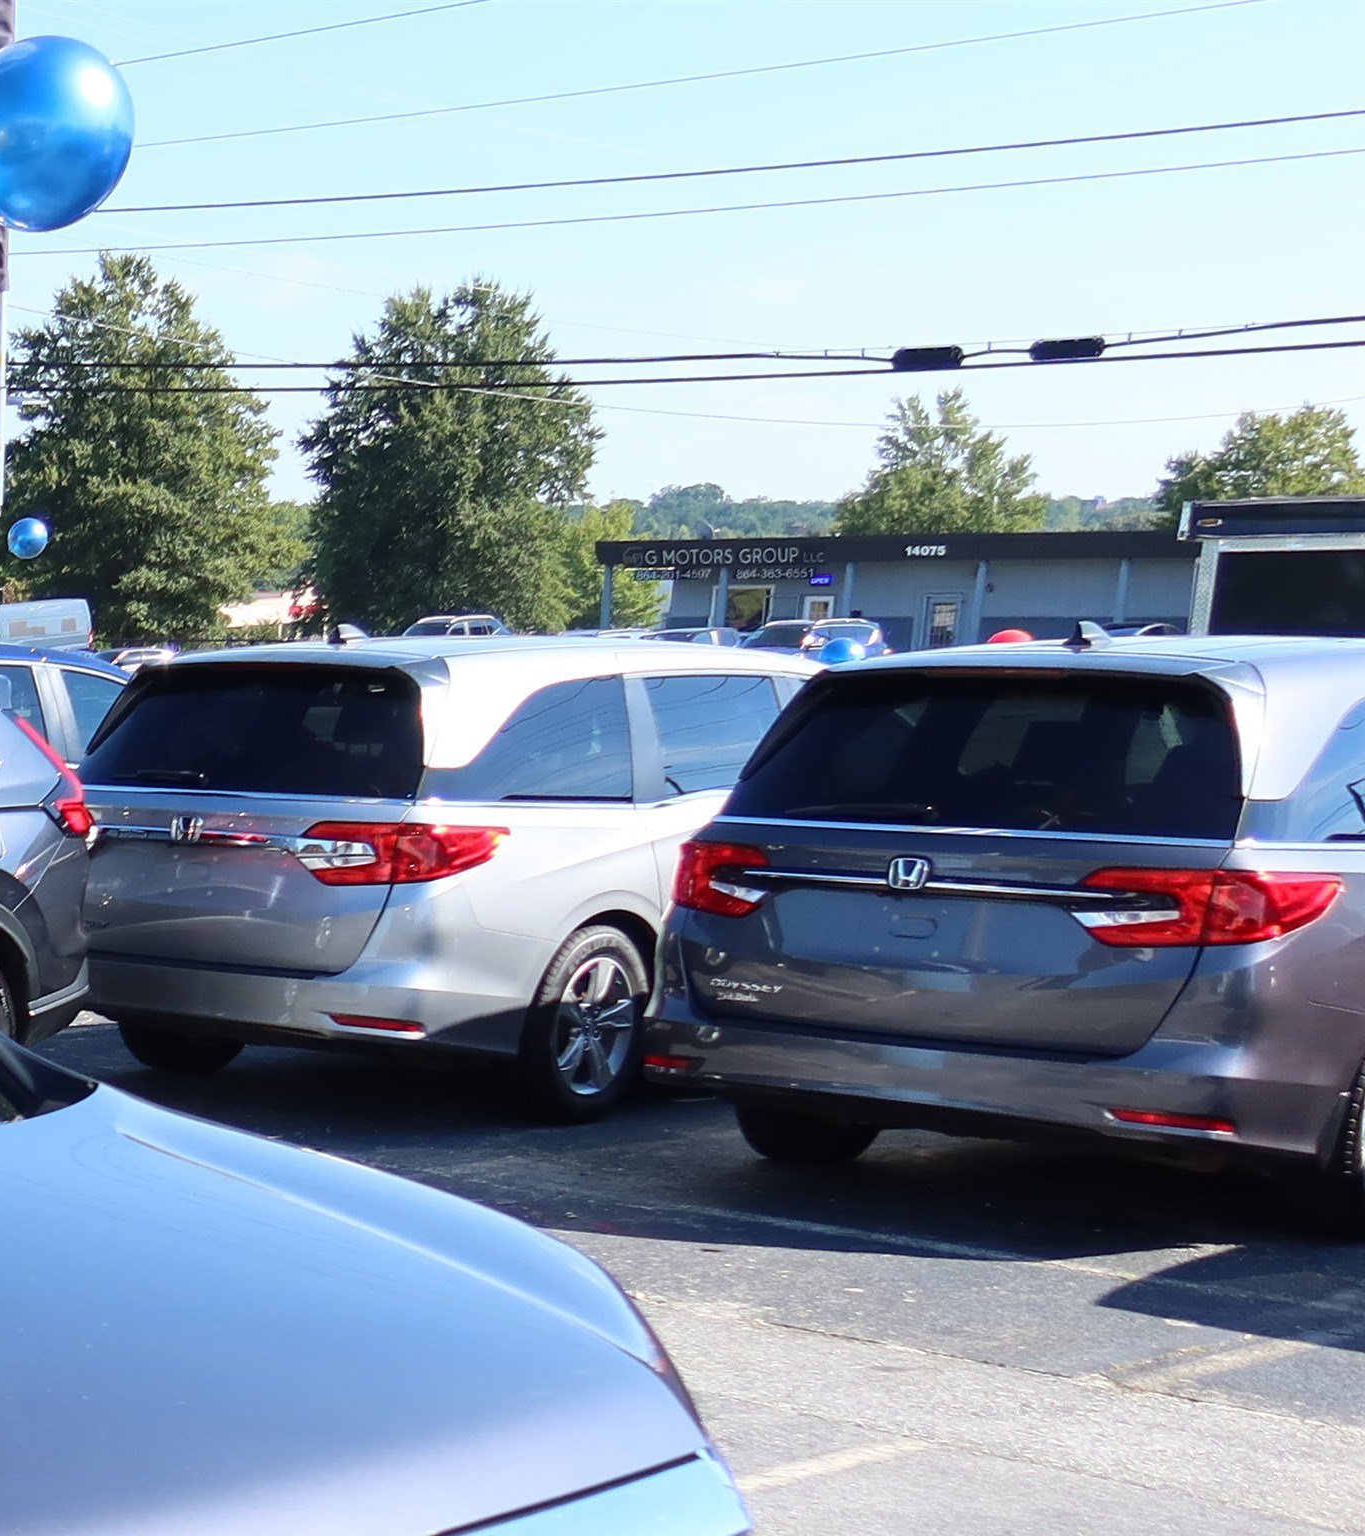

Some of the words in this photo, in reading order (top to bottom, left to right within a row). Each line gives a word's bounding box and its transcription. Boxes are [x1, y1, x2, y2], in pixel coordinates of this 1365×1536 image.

[644, 549, 657, 565] G
[662, 548, 733, 565] MOTORS
[738, 547, 799, 565] GROUP
[803, 551, 825, 563] LLC
[904, 545, 947, 557] 14075
